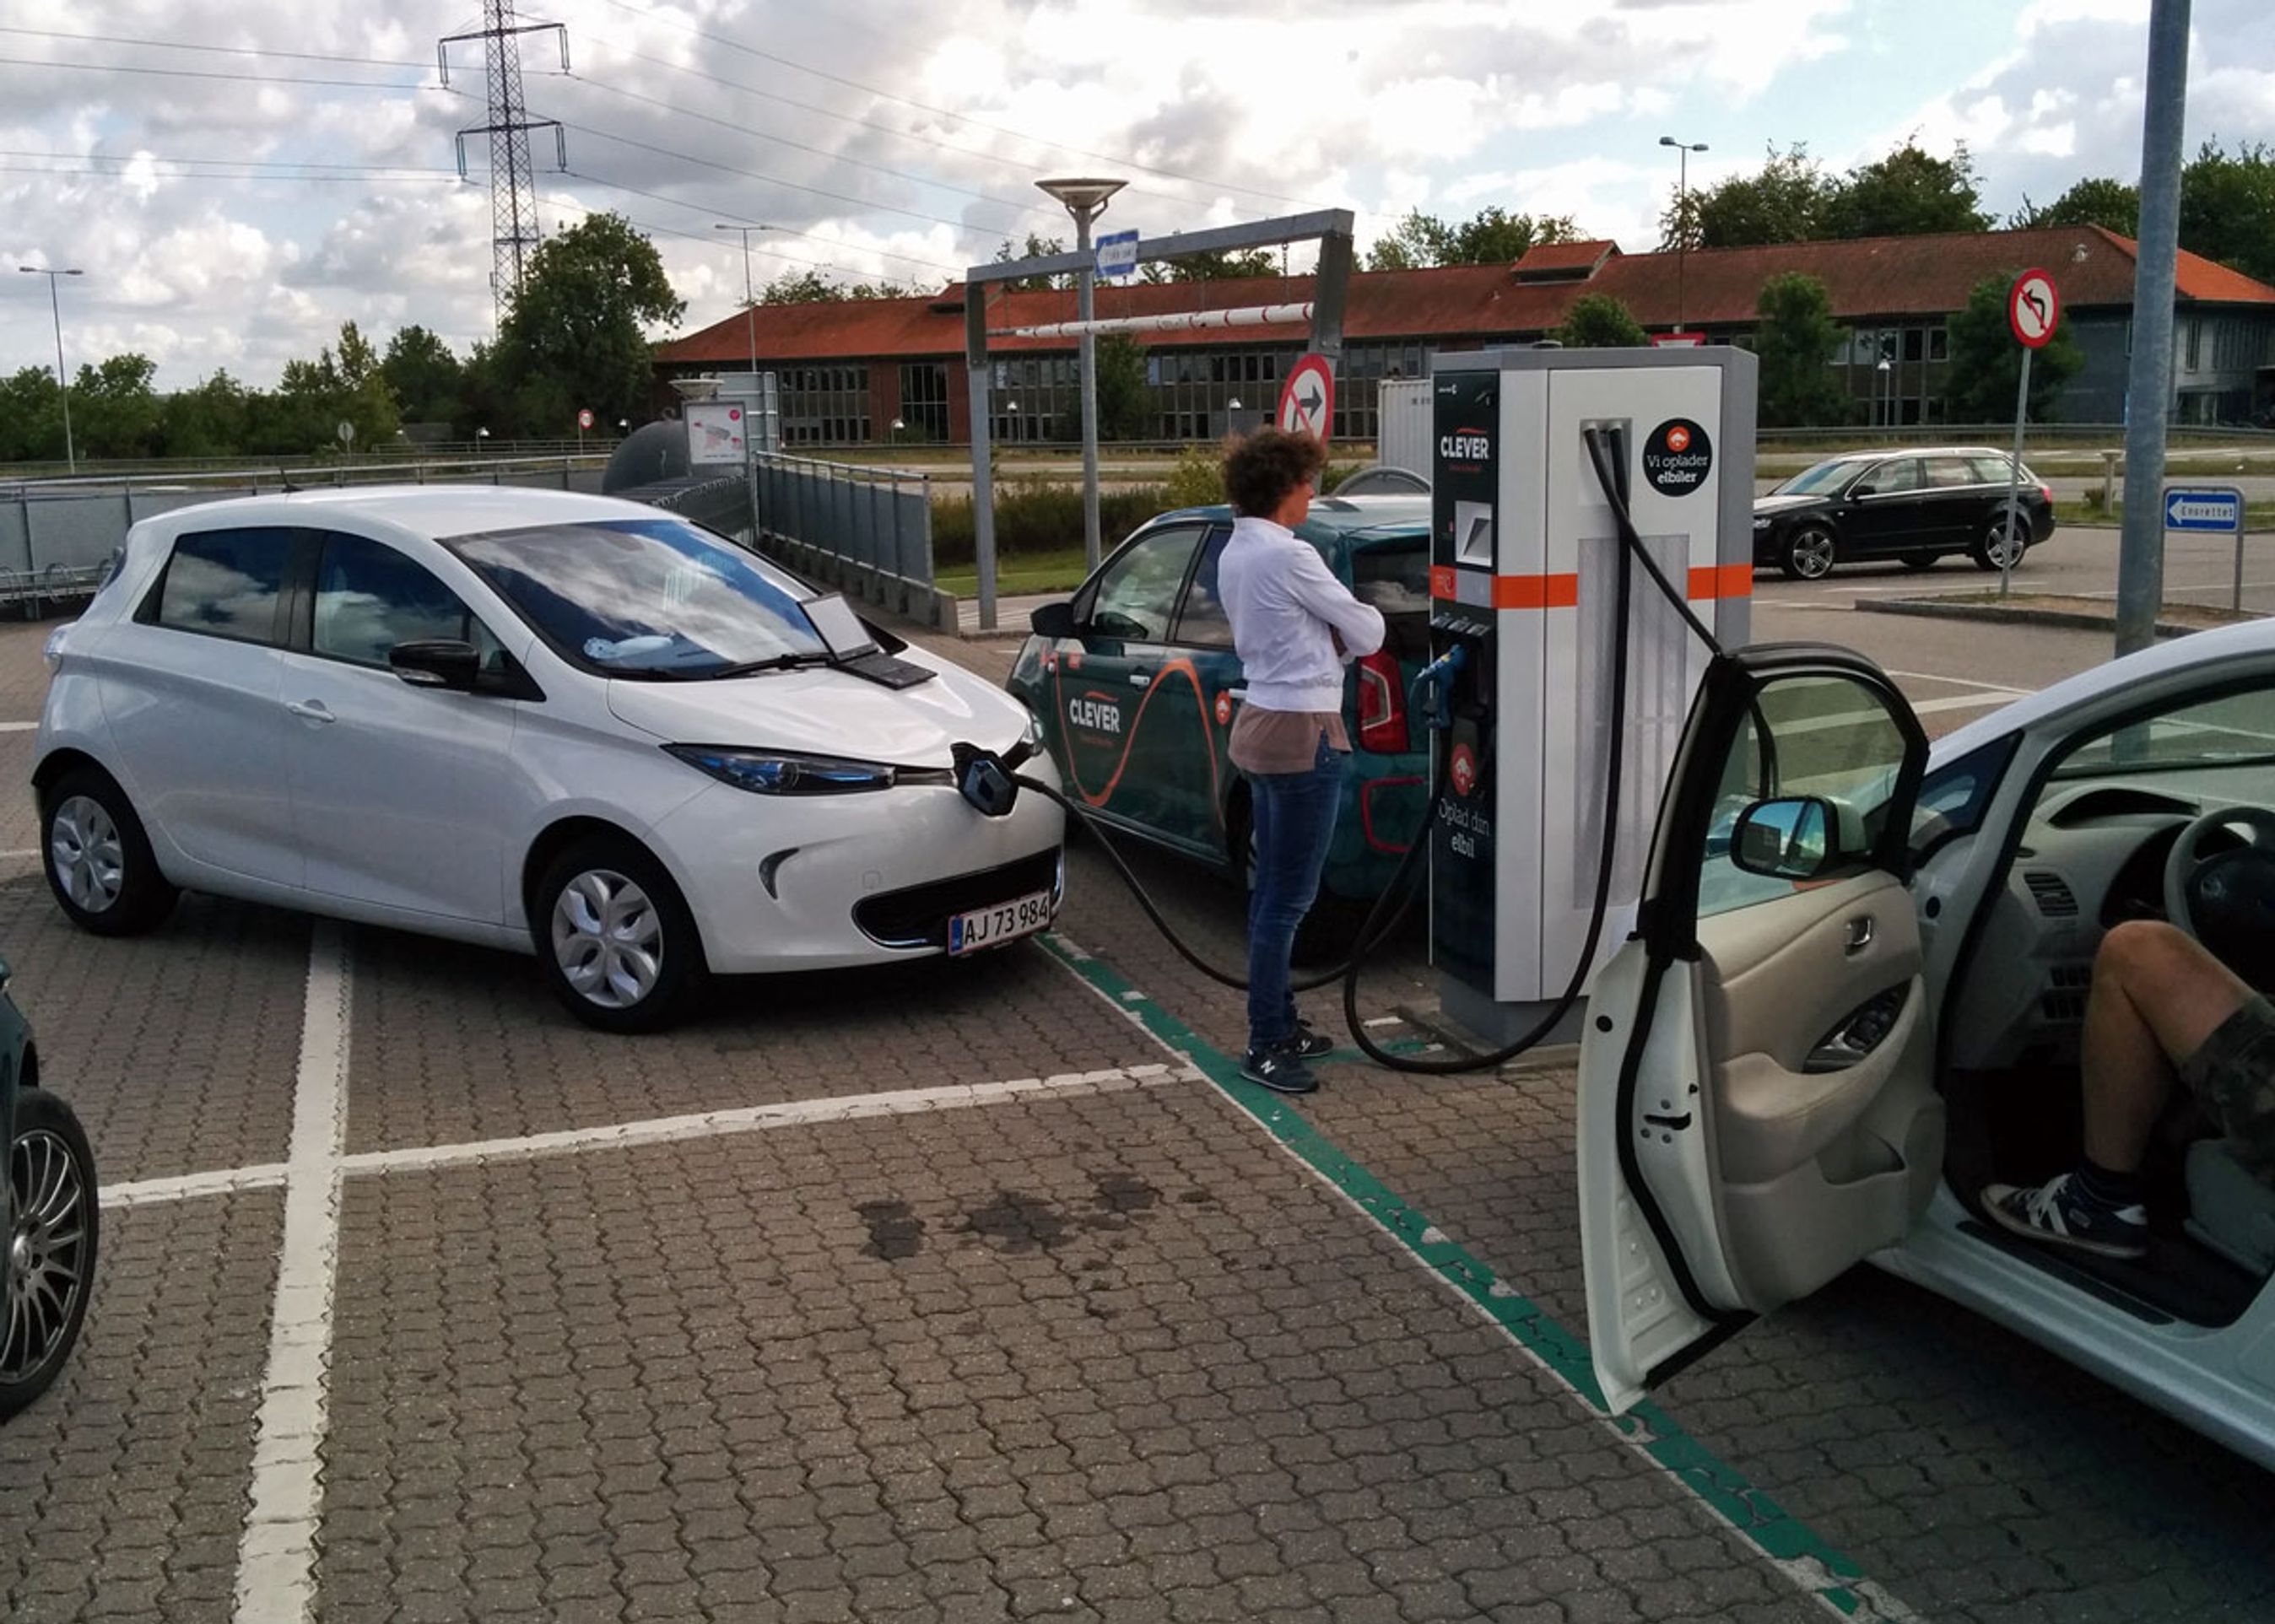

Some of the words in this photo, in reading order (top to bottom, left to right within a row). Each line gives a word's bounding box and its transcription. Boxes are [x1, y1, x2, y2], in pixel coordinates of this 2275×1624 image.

[1440, 436, 1489, 460] CLEVER
[1646, 455, 1661, 467] Vi
[1662, 454, 1708, 471] oplader
[1656, 471, 1697, 484] elbiler
[1069, 698, 1121, 733] CLEVER
[1439, 797, 1469, 828] Oplad
[1452, 832, 1474, 858] elbil
[965, 915, 988, 944] AJ
[995, 907, 1014, 936] 73
[1019, 896, 1048, 928] 984
